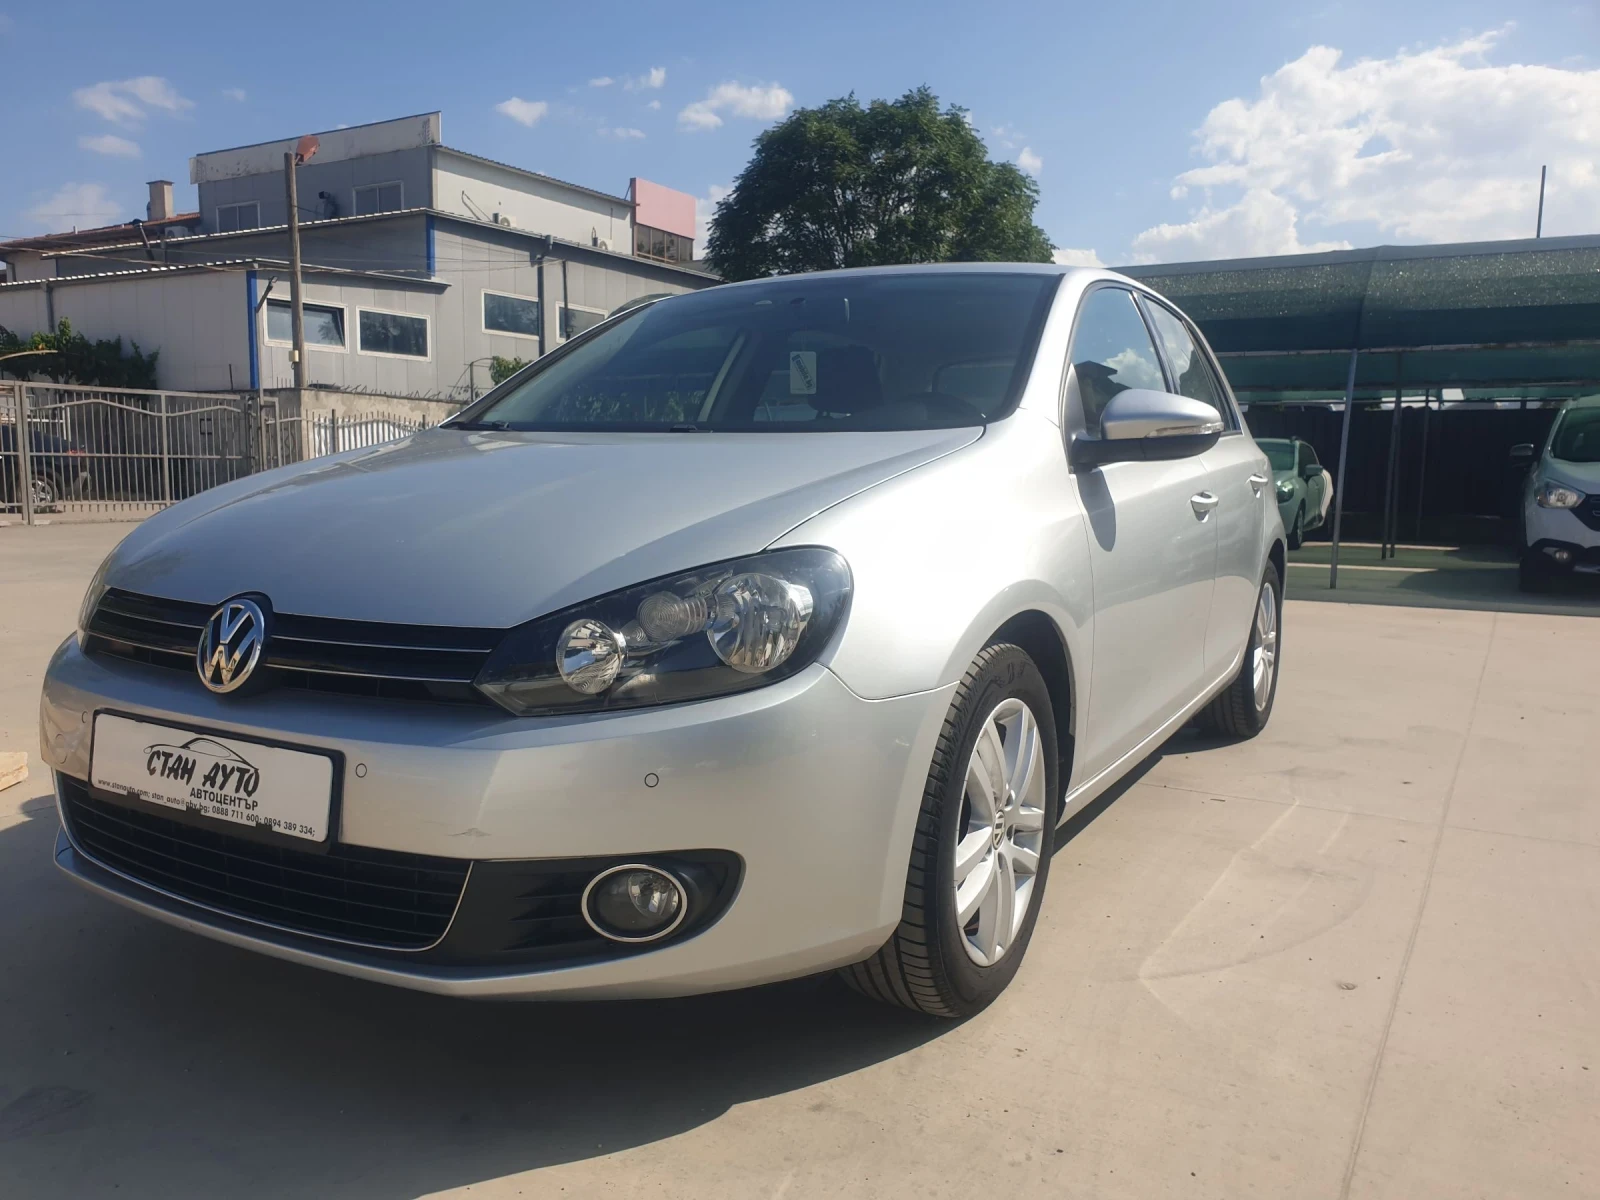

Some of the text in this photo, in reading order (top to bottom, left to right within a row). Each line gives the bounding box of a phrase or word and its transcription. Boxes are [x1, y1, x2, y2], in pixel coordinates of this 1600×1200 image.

[196, 598, 265, 694] VW
[146, 749, 260, 798] СТАН АУТО
[189, 787, 258, 811] АВТОЦЕНТЪР
[211, 805, 229, 817] 0888
[231, 809, 244, 820] 711
[264, 817, 281, 828] 0894
[283, 821, 297, 832] 389
[299, 824, 316, 837] 334;
